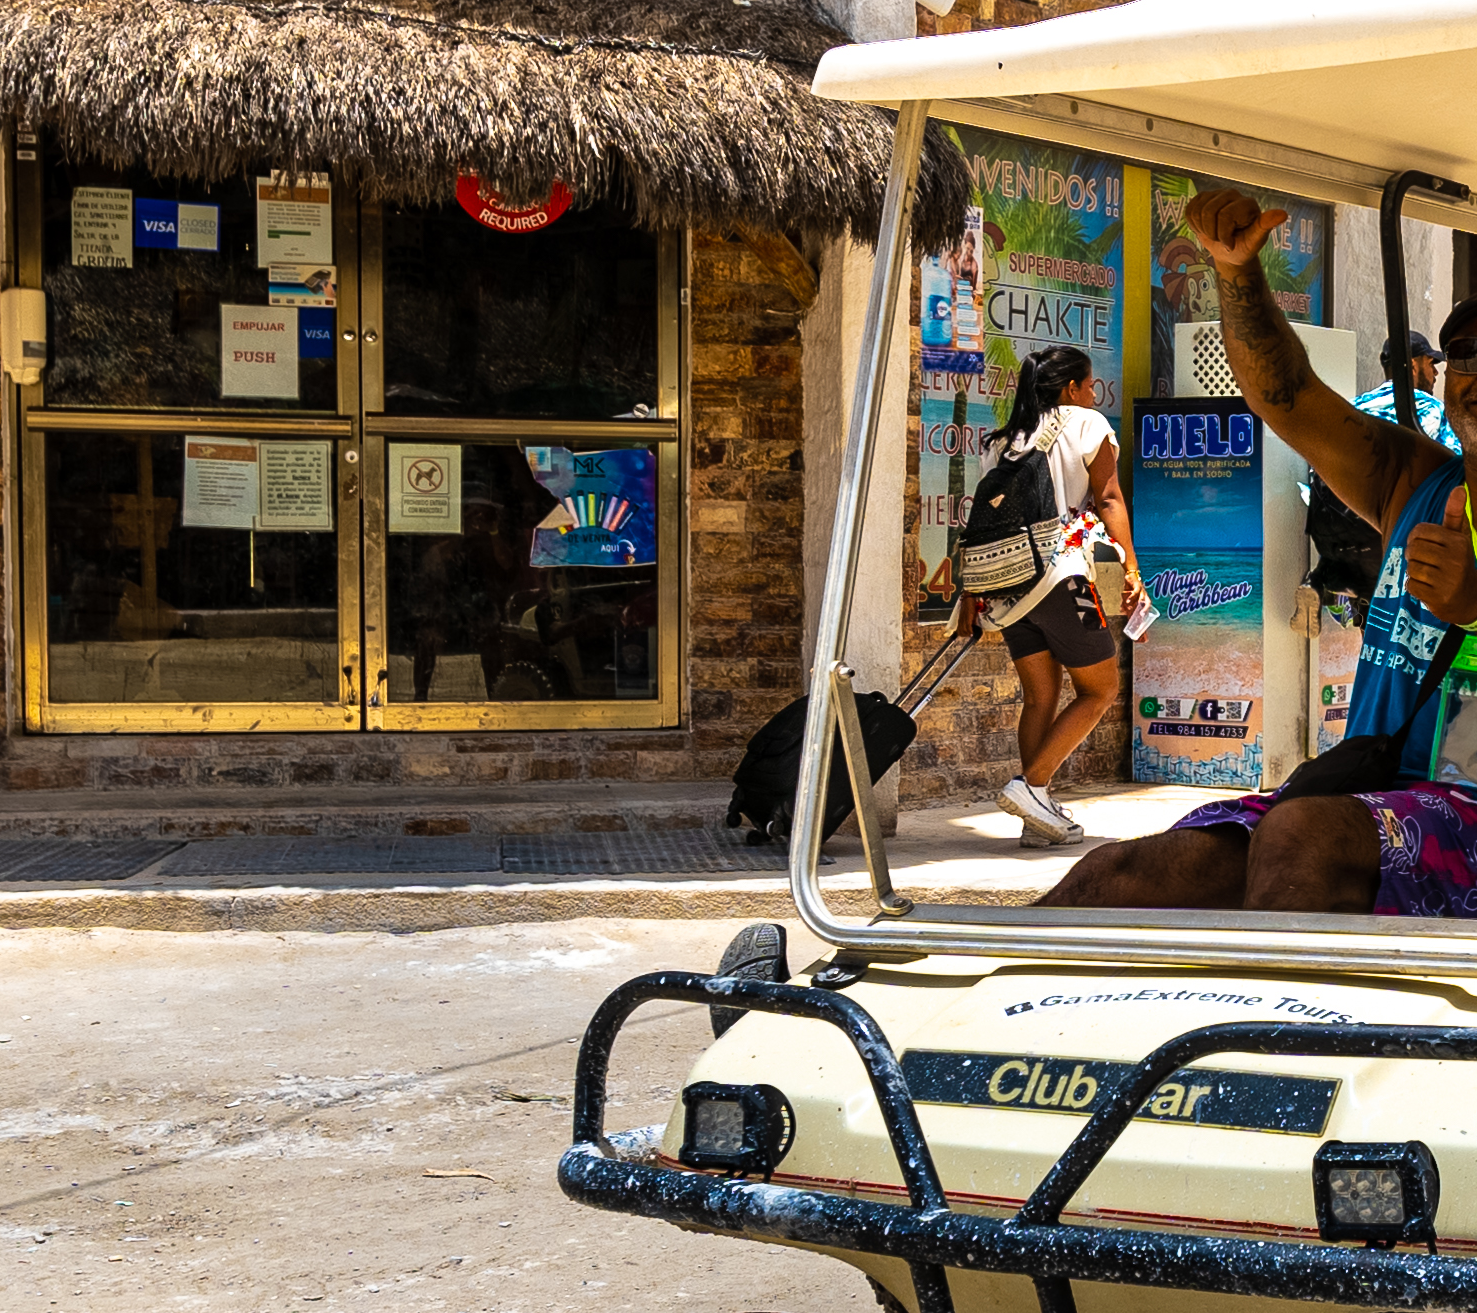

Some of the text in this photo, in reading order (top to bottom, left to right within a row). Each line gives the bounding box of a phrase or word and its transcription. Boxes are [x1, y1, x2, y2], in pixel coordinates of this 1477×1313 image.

[180, 218, 216, 228] CLOSED
[479, 208, 548, 230] REQUIRED
[143, 220, 176, 233] VISA
[180, 227, 216, 236] CERRADO
[1009, 252, 1115, 288] SUPERMERCADO
[988, 290, 1108, 344] CHAKTE
[233, 321, 285, 332] EMPUJAR
[304, 329, 331, 339] VISA
[233, 350, 276, 363] PUSH
[1141, 413, 1254, 459] HIELO
[574, 457, 605, 474] MK
[1207, 460, 1251, 468] PURIFICADA
[1206, 470, 1233, 478] SODIO
[567, 533, 611, 543] DE VENTA
[1144, 567, 1207, 600] Maya
[1168, 581, 1252, 620] Caribbean
[1153, 724, 1244, 737] TEL: 984 157 4733
[1040, 989, 1263, 1008] GamaExtreme
[988, 1060, 1212, 1118] Club ar
